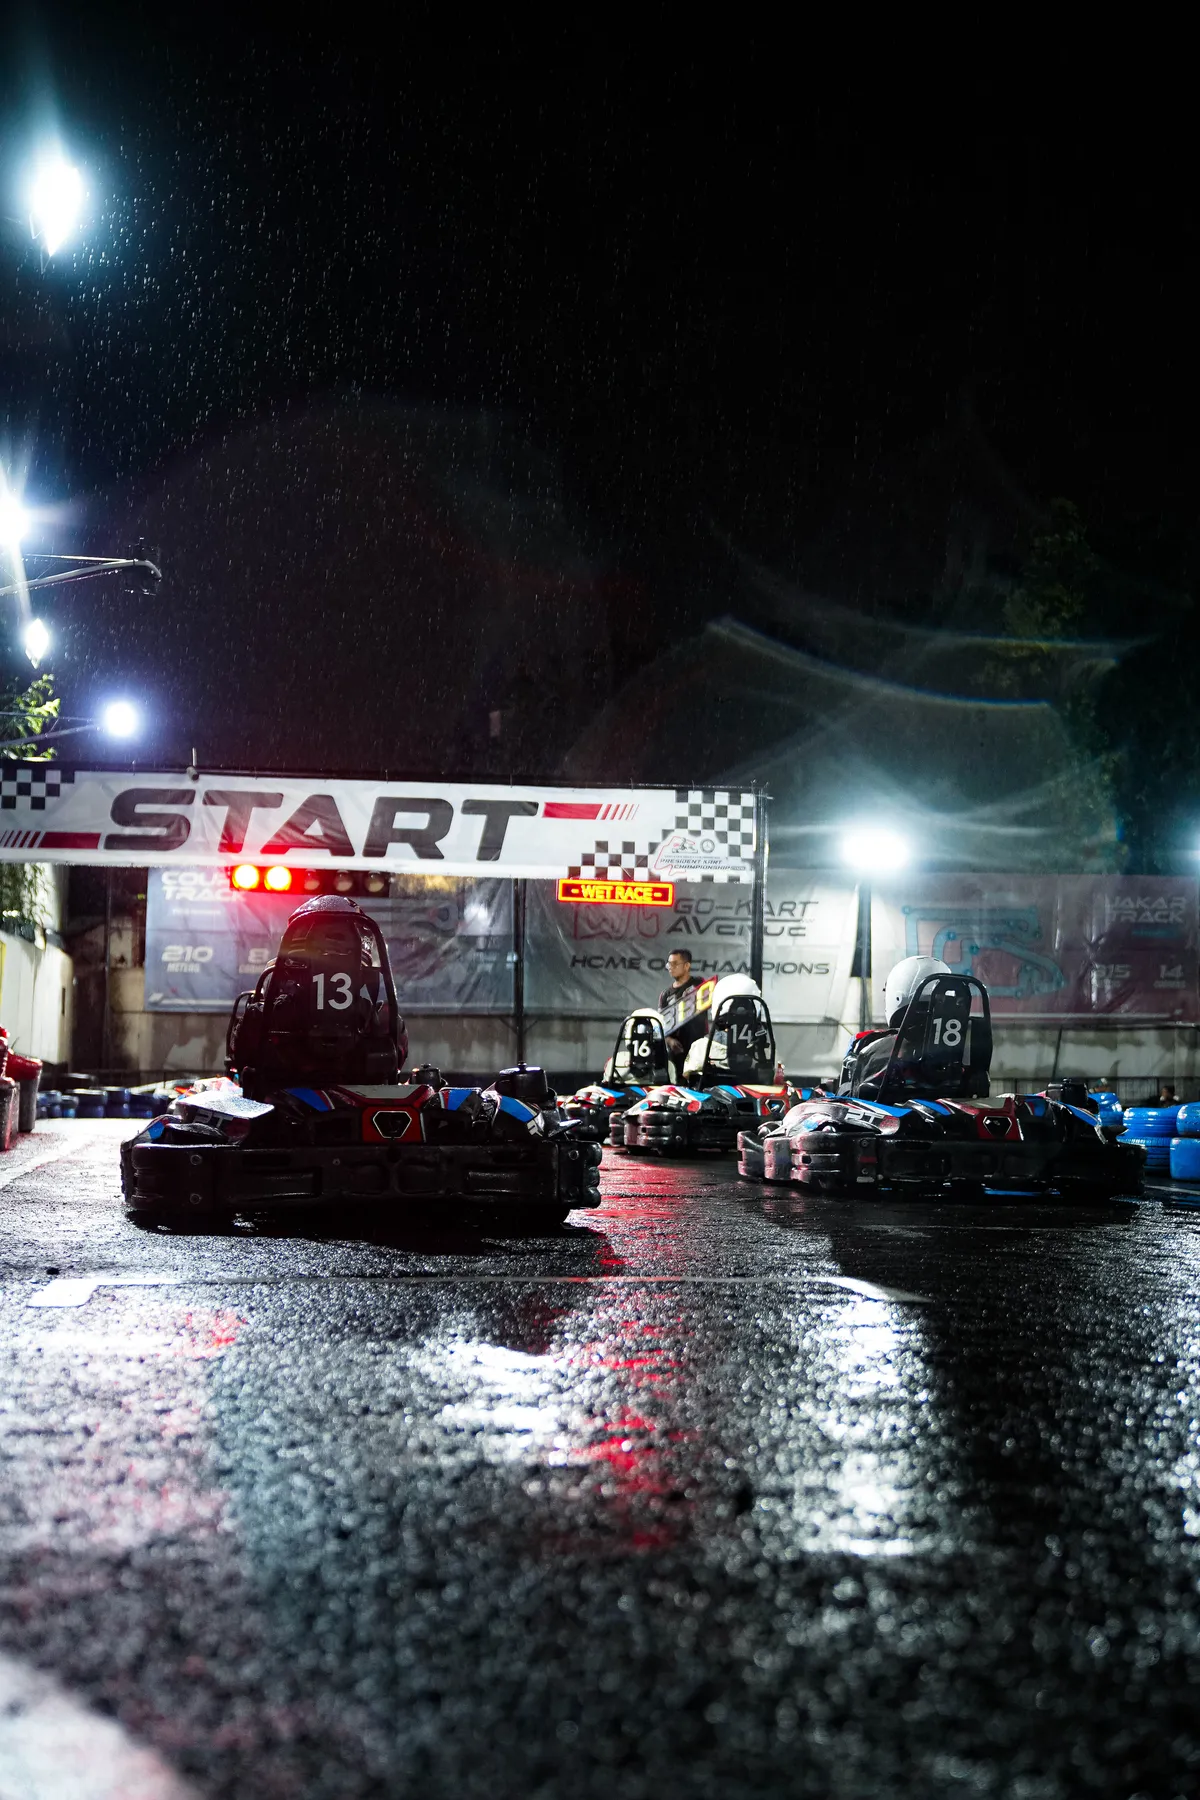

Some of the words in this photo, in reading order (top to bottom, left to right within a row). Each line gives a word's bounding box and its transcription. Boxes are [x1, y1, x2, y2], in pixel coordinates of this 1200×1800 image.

[104, 787, 539, 861] START
[673, 863, 730, 871] CHAMPIONSHIP
[162, 885, 246, 902] TRACK
[581, 884, 613, 899] WET
[615, 886, 653, 902] RACE
[673, 898, 819, 917] GO-KART
[161, 945, 213, 963] 210
[691, 958, 830, 975] CHAMPIONS
[312, 972, 353, 1010] 13
[730, 1024, 752, 1044] 14
[933, 1017, 962, 1047] 18
[632, 1040, 651, 1058] 16
